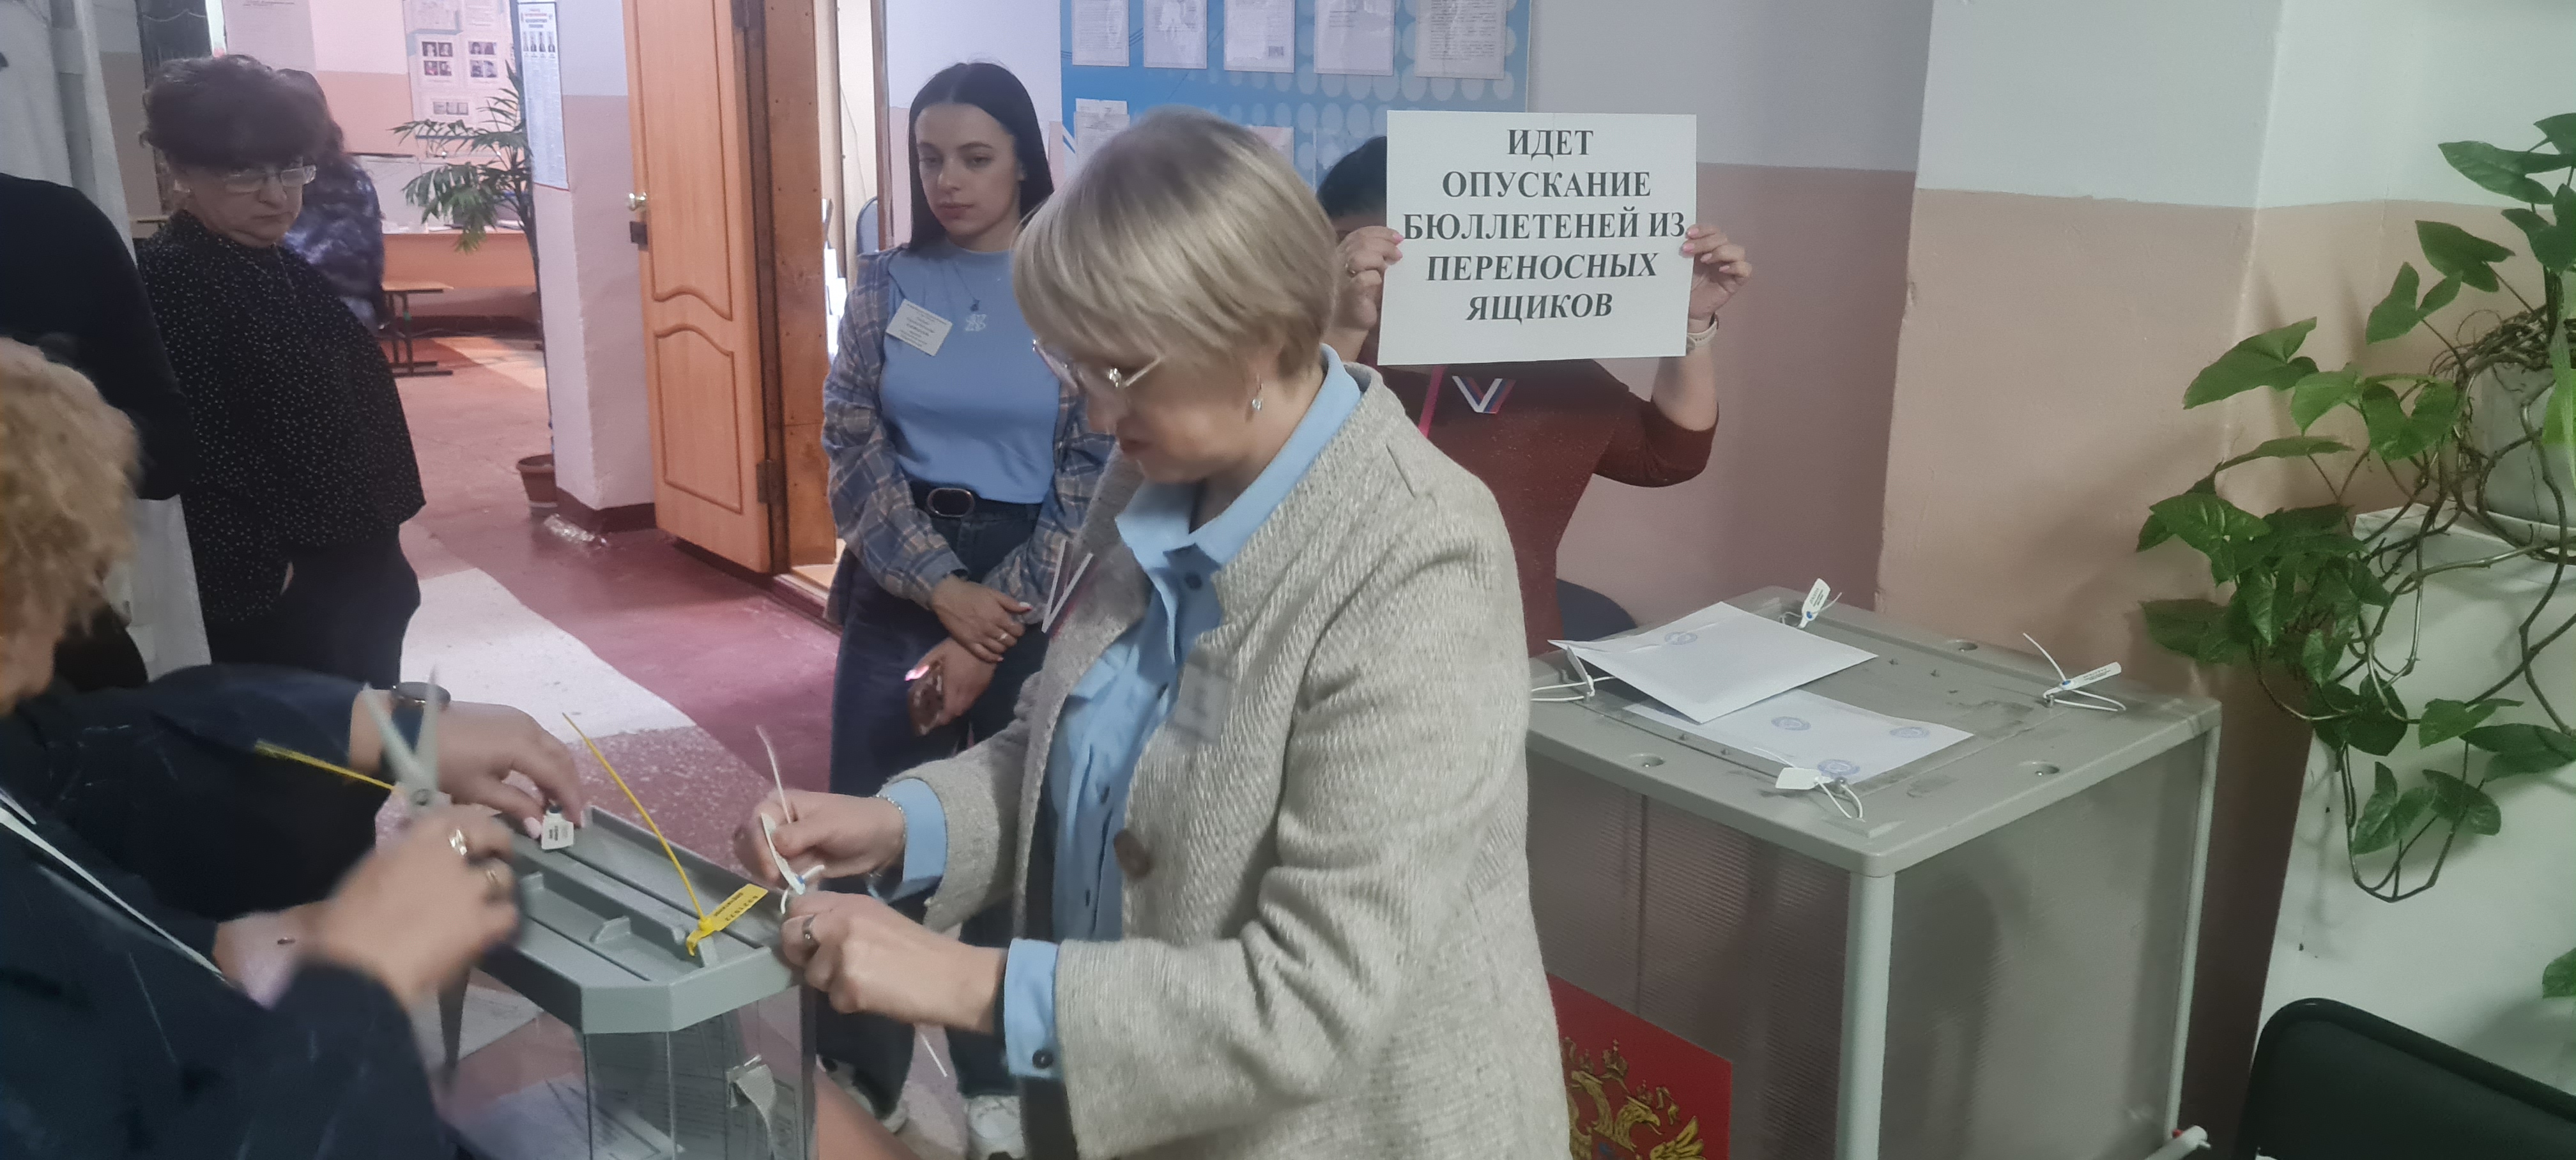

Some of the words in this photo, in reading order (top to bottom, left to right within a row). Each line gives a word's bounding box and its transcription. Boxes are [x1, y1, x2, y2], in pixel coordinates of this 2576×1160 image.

[1508, 128, 1595, 161] ИДЕТ
[1442, 171, 1652, 198] ОПУСКАНИЕ
[1403, 206, 1638, 240] БЮЛЛЕТЕНЕЙ
[1648, 212, 1685, 237] ИЗ
[1427, 252, 1659, 281] ПЕРЕНОСНЫХ
[1466, 293, 1613, 324] ЯЩИКОВ
